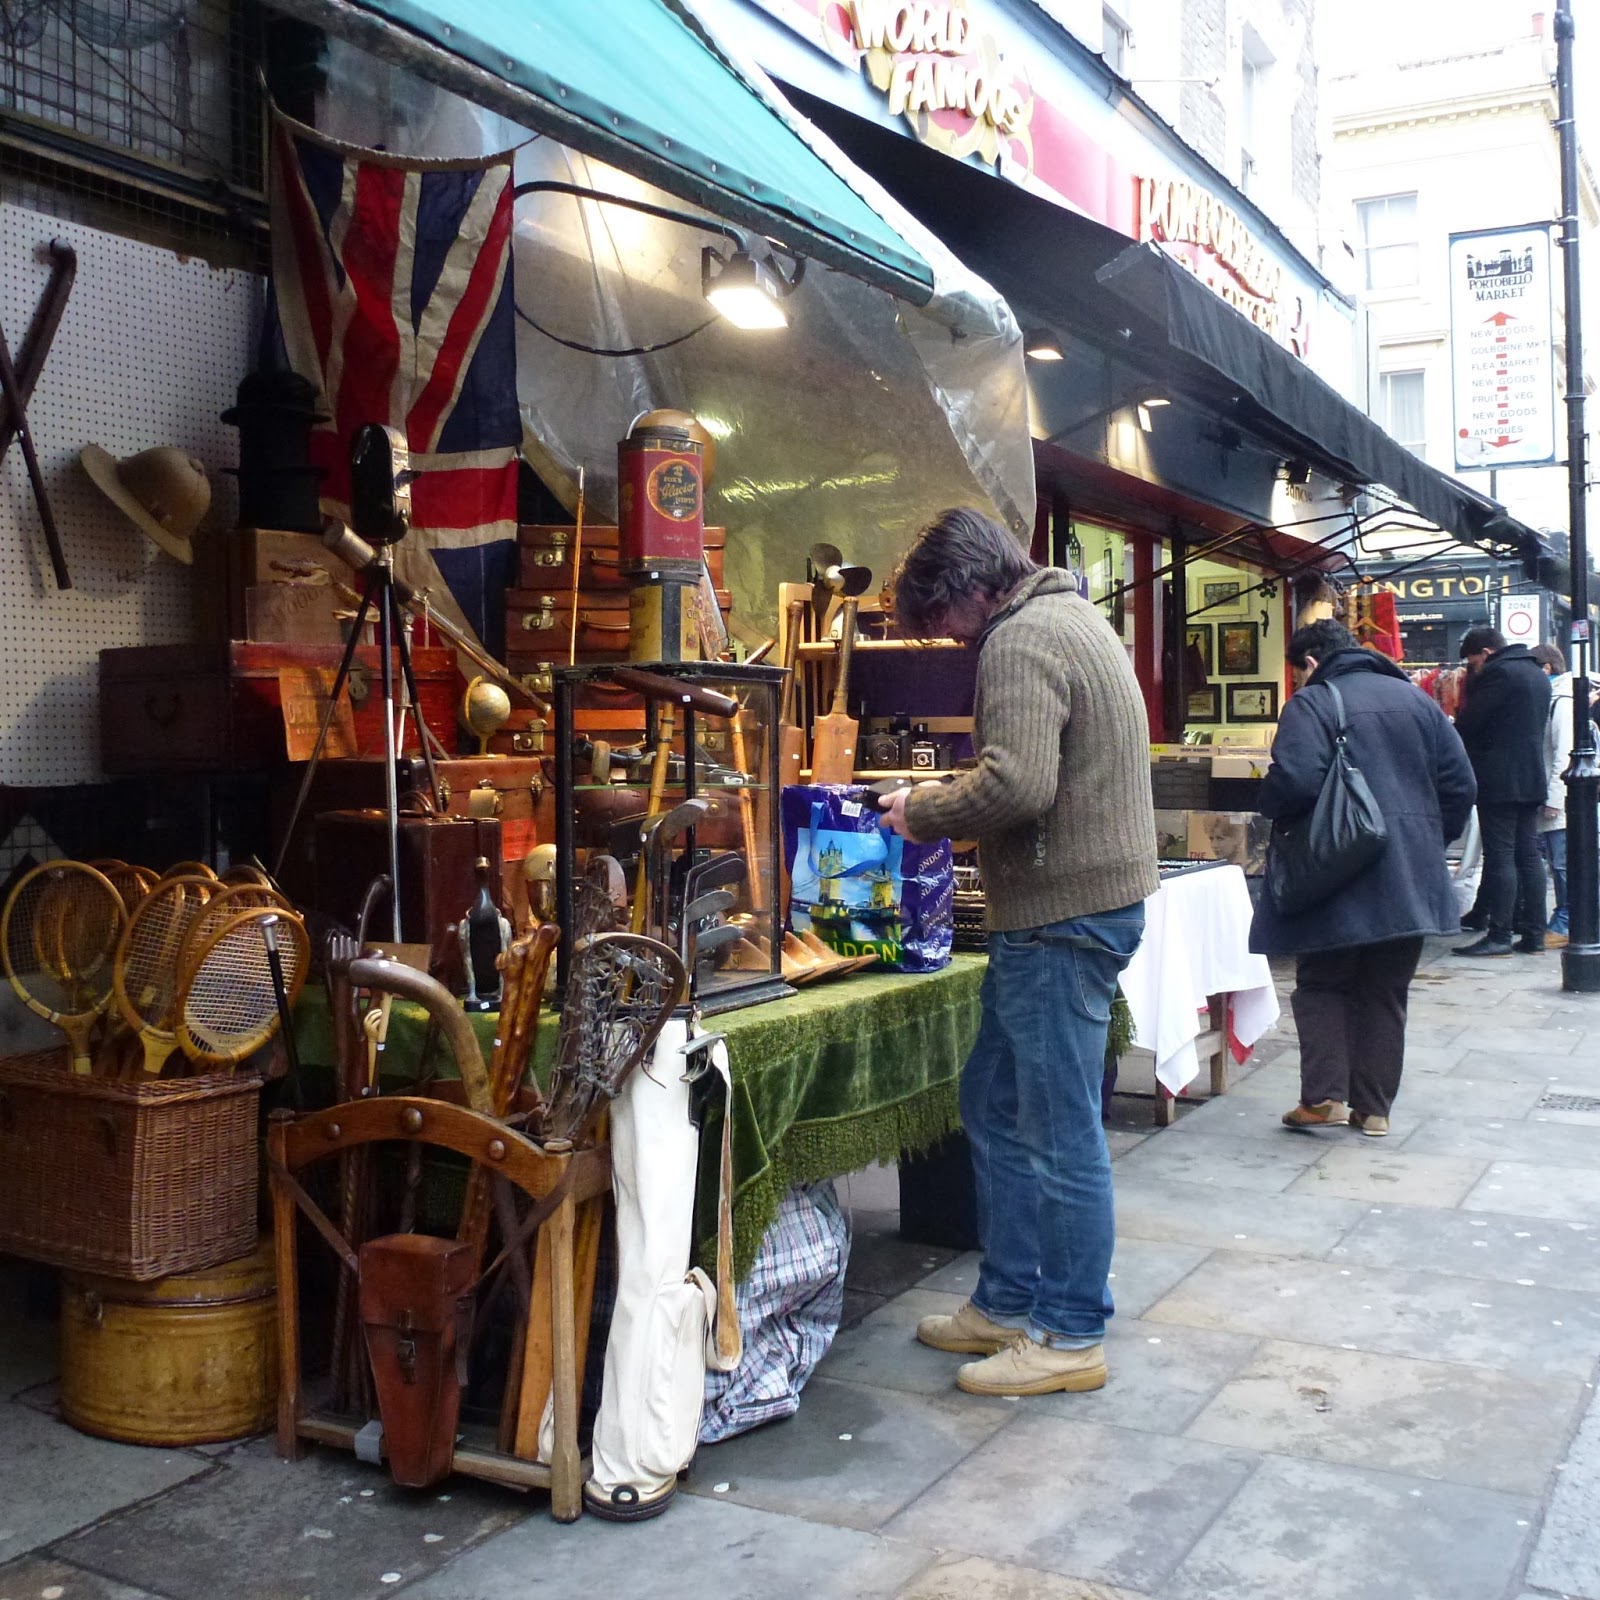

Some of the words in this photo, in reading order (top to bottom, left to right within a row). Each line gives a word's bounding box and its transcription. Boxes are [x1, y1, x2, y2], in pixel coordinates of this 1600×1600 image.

[849, 0, 971, 53] WORLD
[888, 59, 1034, 133] FAMOUS
[1469, 272, 1533, 290] PORTOBELLO
[1475, 287, 1526, 302] MARKET
[1470, 330, 1493, 339] NEW
[1498, 325, 1535, 336] GOODS
[1471, 344, 1522, 355] GOLBORNE
[1527, 340, 1547, 349] MKT
[1471, 362, 1495, 371] FLEA
[1500, 357, 1540, 368] MARKET
[1472, 379, 1494, 388] NEW
[1498, 375, 1536, 386] GOODS
[1472, 394, 1499, 404] FRUIT
[1515, 391, 1534, 400] VEG
[1473, 412, 1495, 420] NEW
[1500, 407, 1538, 418] GOODS
[1474, 425, 1524, 437] ANTIQUES
[1508, 602, 1532, 610] ZONE
[918, 846, 945, 874] ONDON
